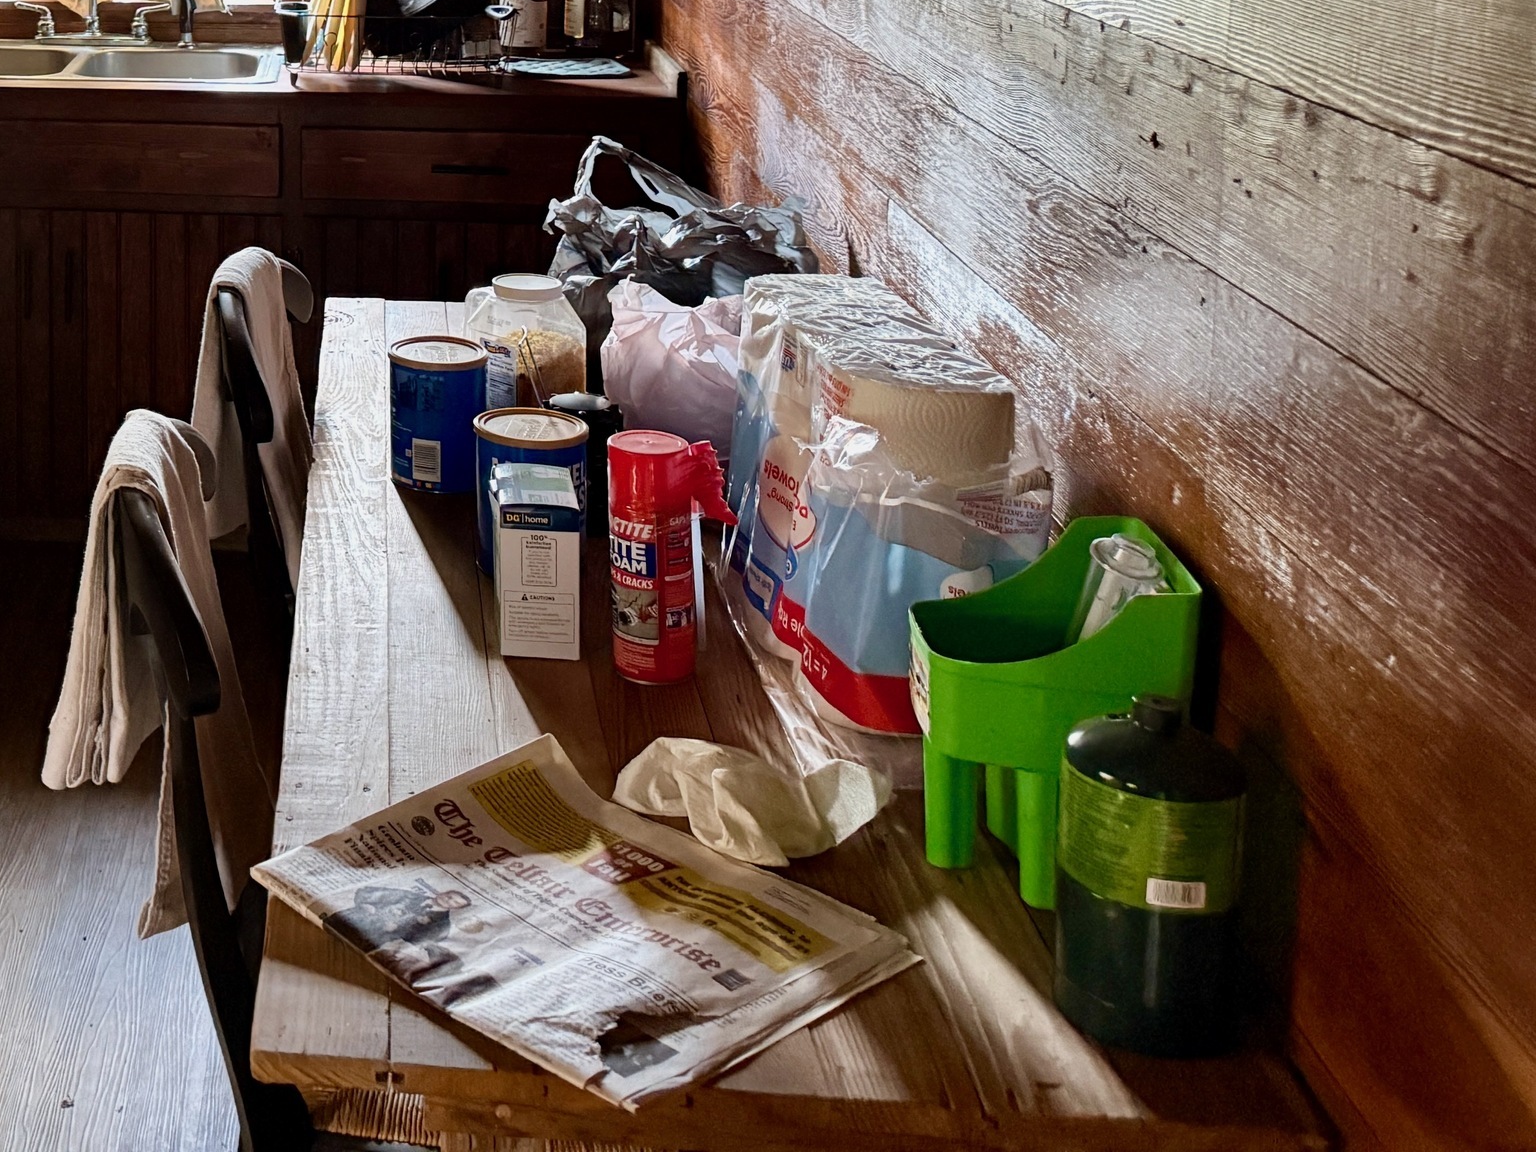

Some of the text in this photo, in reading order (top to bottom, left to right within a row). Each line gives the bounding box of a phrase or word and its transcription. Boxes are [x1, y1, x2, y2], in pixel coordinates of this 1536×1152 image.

[525, 514, 548, 524] home
[622, 576, 654, 589] CRACKS
[948, 586, 966, 597] els
[613, 844, 665, 873] $1000
[615, 858, 632, 868] or
[587, 858, 632, 882] Jail
[434, 799, 483, 847] The
[484, 846, 575, 898] Telfair
[575, 898, 722, 972] Enterprise
[577, 956, 627, 979] Press
